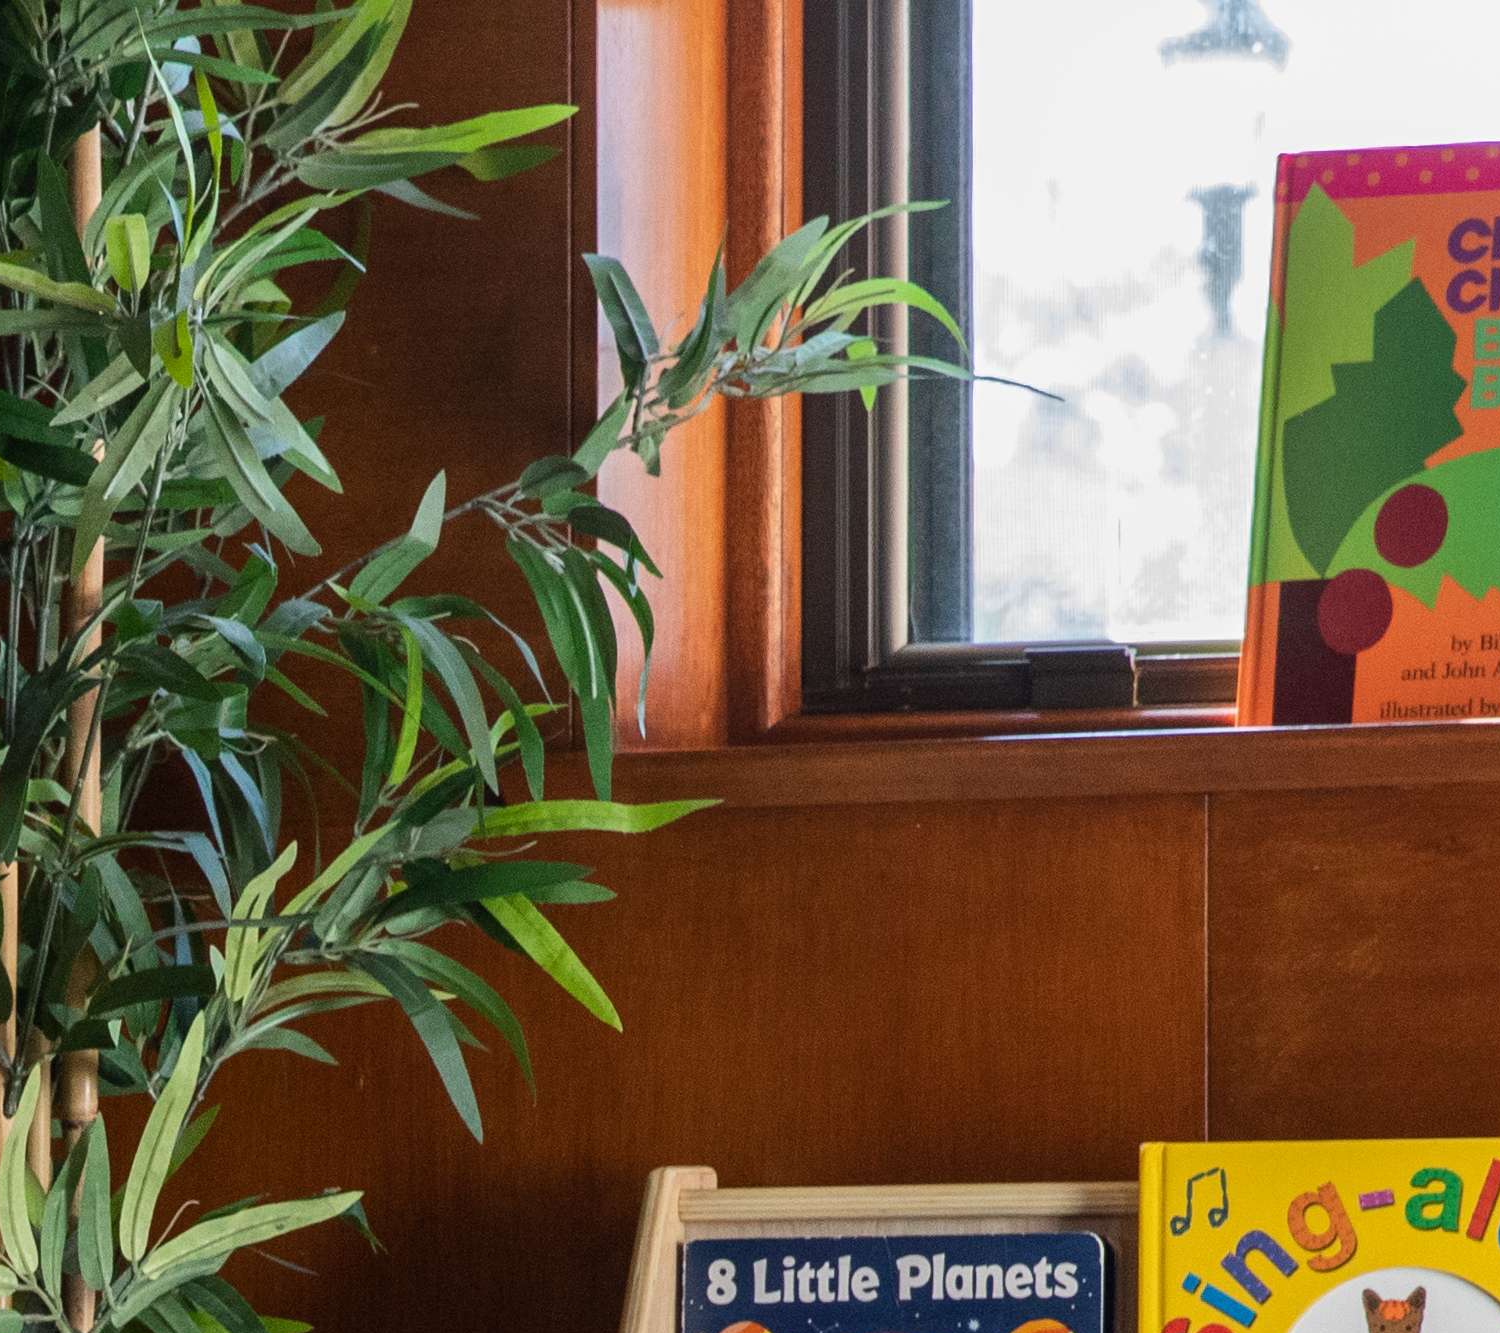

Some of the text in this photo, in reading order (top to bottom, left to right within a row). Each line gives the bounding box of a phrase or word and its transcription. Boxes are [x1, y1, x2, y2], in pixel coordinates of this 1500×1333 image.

[1450, 634, 1473, 656] by
[1401, 661, 1436, 681] and
[1442, 661, 1486, 680] John
[1379, 698, 1473, 719] illustrated
[1479, 697, 1500, 716] by
[706, 1252, 1080, 1306] 8 Little Planets
